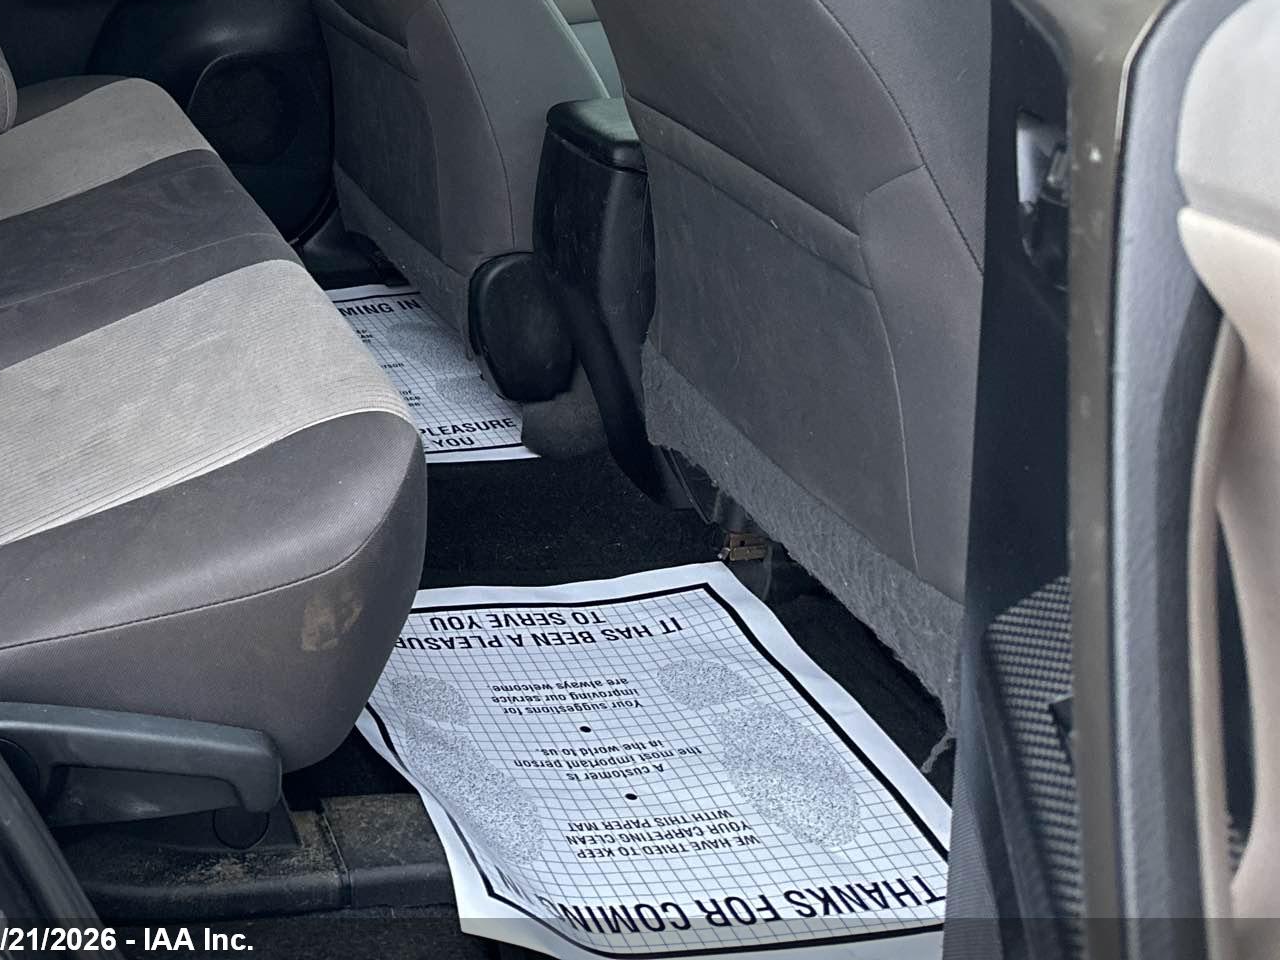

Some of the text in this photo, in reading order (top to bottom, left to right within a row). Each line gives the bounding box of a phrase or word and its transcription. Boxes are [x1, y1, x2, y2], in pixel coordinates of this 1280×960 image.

[337, 299, 422, 317] MING IN
[432, 437, 475, 448] YOU
[429, 609, 607, 631] TO SERVE YOU
[653, 617, 683, 634] IT
[506, 634, 525, 648] A
[530, 630, 597, 646] BEEN
[601, 625, 653, 641] HAS
[555, 680, 603, 690] always
[606, 678, 629, 686] are
[491, 695, 540, 704] service
[569, 688, 639, 701] improving
[503, 699, 643, 716] Your suggestions for
[580, 745, 619, 757] world
[623, 741, 646, 752] the
[649, 739, 664, 748] in
[514, 746, 701, 770] the most important person
[562, 748, 577, 758] to
[566, 763, 664, 782] A customer is
[566, 809, 734, 833] WITH THIS PAPER MAT
[565, 820, 752, 845] YOUR CARPETING CLEAN
[577, 834, 760, 859] WE HAVE TRIED TO KEEP
[783, 876, 946, 919] THANKS
[694, 895, 778, 928] FOR
